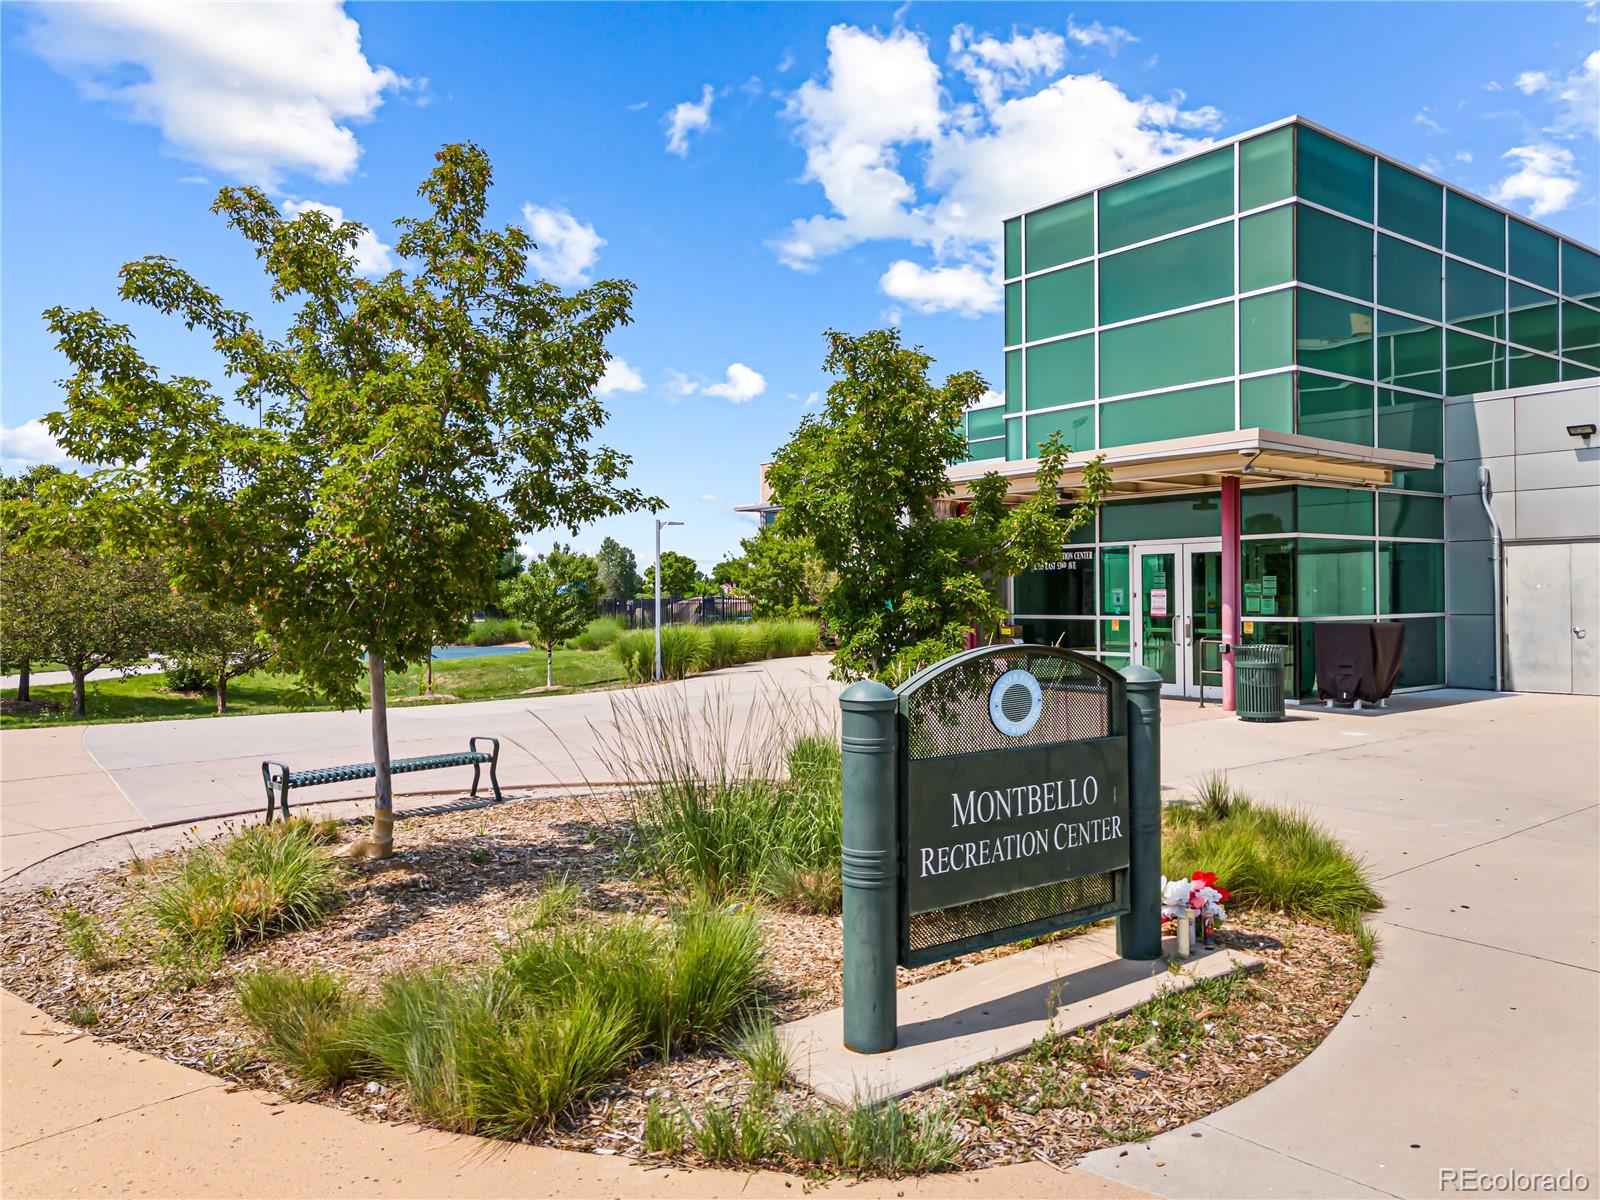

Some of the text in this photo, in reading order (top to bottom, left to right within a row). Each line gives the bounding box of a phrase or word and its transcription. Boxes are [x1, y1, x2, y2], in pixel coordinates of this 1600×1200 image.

[951, 775, 1098, 828] MONTBELLO
[920, 815, 1123, 877] RECREATION CENTER
